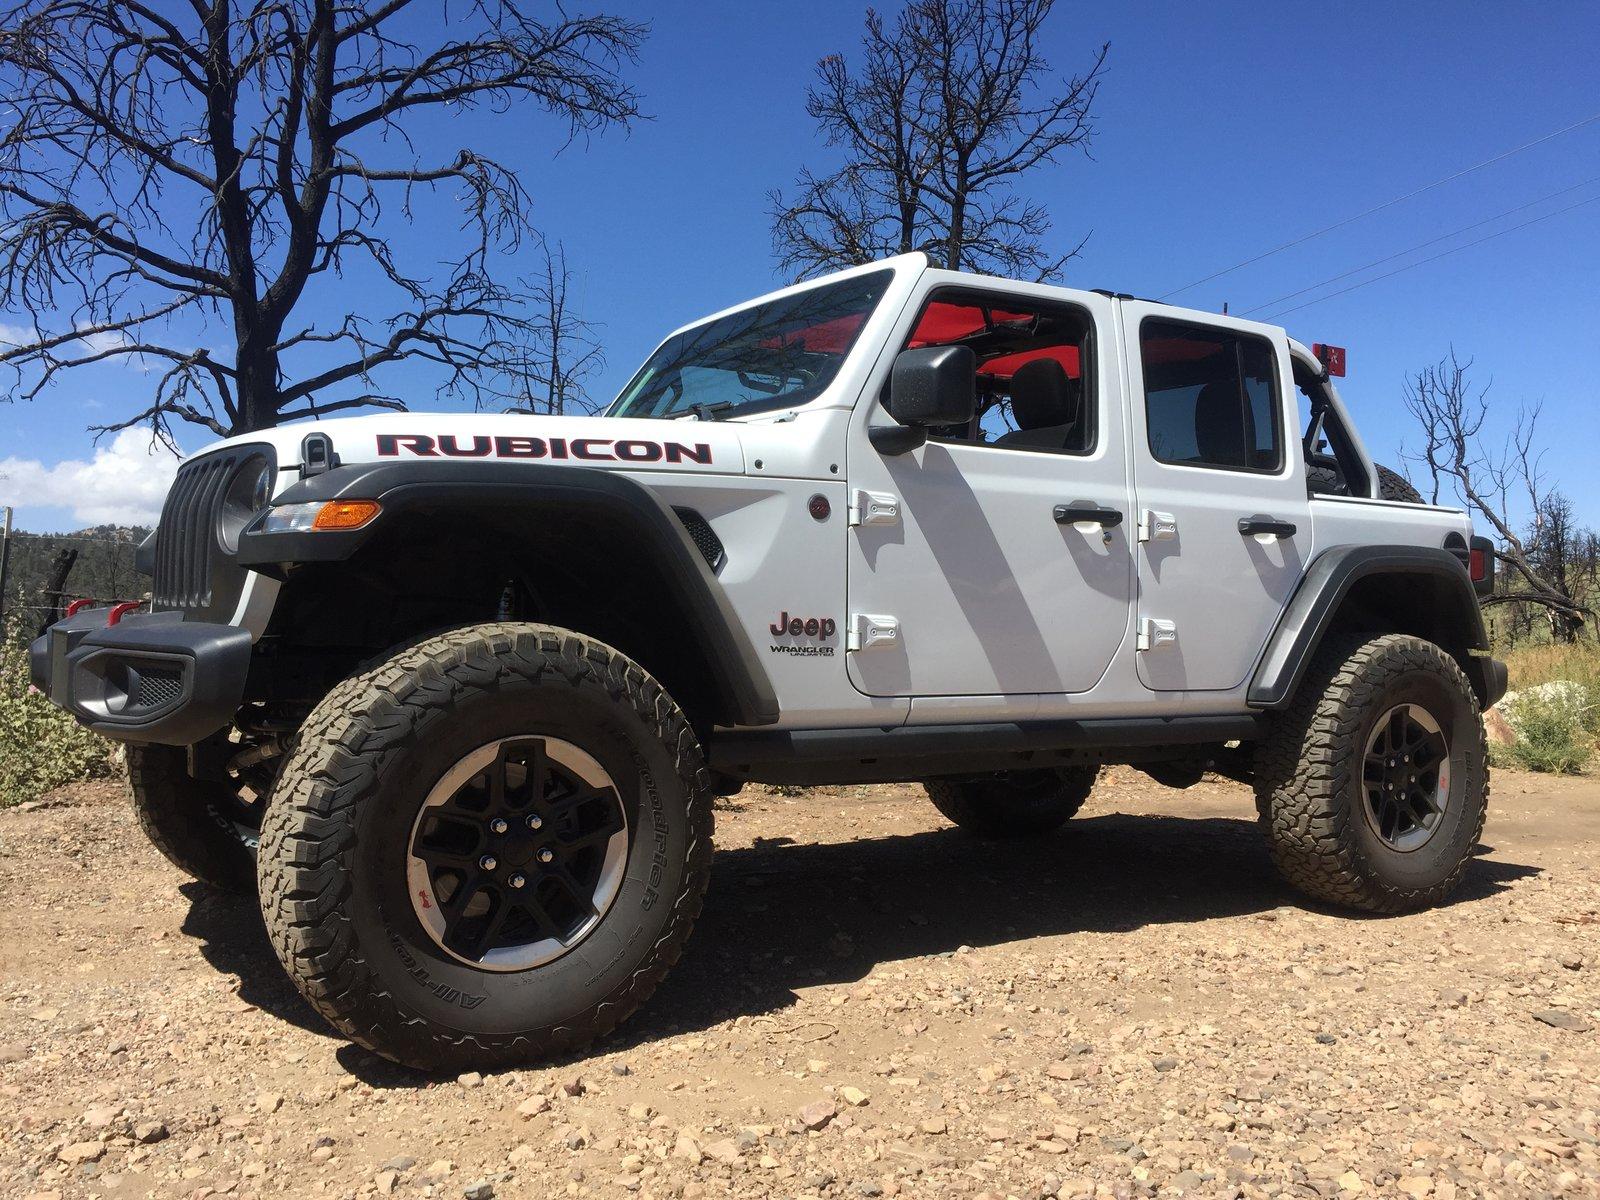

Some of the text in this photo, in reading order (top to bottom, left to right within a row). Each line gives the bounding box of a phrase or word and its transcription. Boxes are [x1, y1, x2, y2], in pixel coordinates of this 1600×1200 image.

[376, 434, 712, 465] RUBICON
[770, 611, 836, 641] Jeep
[770, 645, 834, 653] WRANGLER
